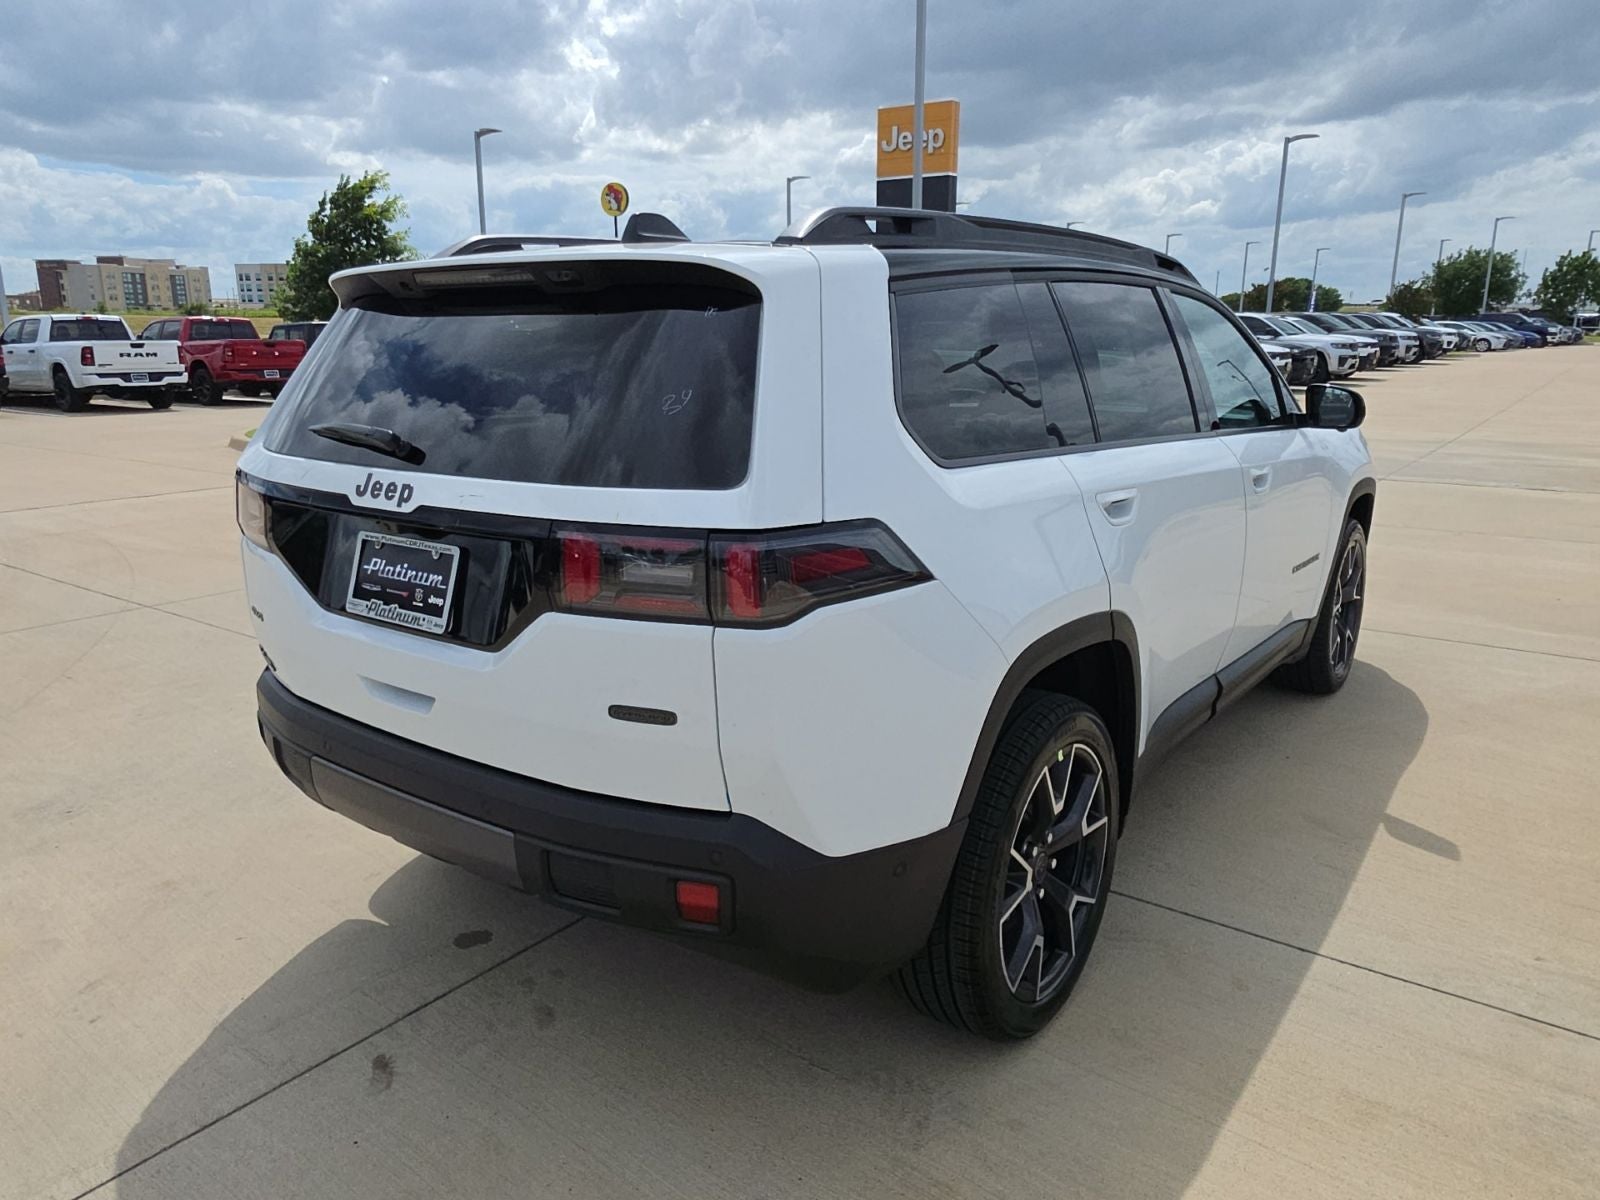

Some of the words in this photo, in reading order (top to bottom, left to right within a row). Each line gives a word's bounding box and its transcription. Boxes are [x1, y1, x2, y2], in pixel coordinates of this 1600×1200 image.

[356, 472, 414, 508] Jeep
[363, 558, 447, 589] Platinum
[367, 600, 424, 627] Platinum
[428, 594, 444, 607] Jeep
